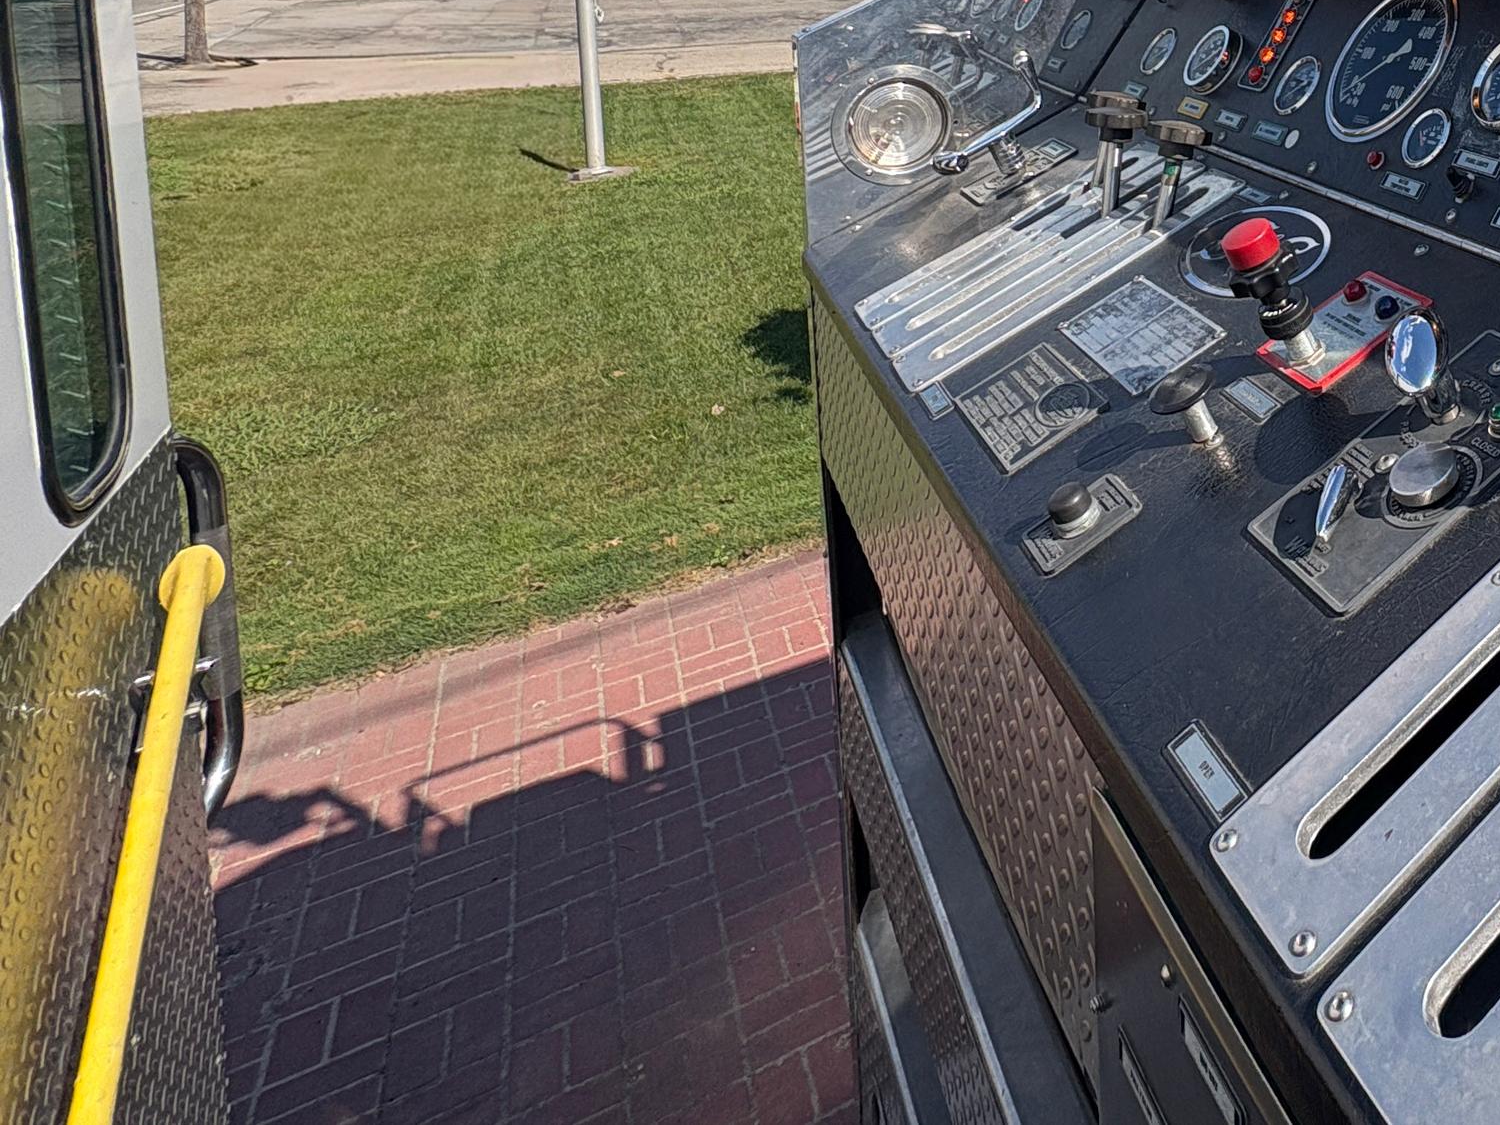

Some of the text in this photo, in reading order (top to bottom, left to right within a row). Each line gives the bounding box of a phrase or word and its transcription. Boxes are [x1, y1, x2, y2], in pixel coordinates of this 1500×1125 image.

[1408, 9, 1425, 21] 300
[1382, 20, 1400, 32] 200
[1418, 26, 1437, 40] 400
[1361, 46, 1376, 59] 100
[1408, 56, 1427, 71] 500
[1386, 85, 1405, 100] 600
[1463, 378, 1491, 405] CREASE
[1471, 437, 1500, 458] CLOSED
